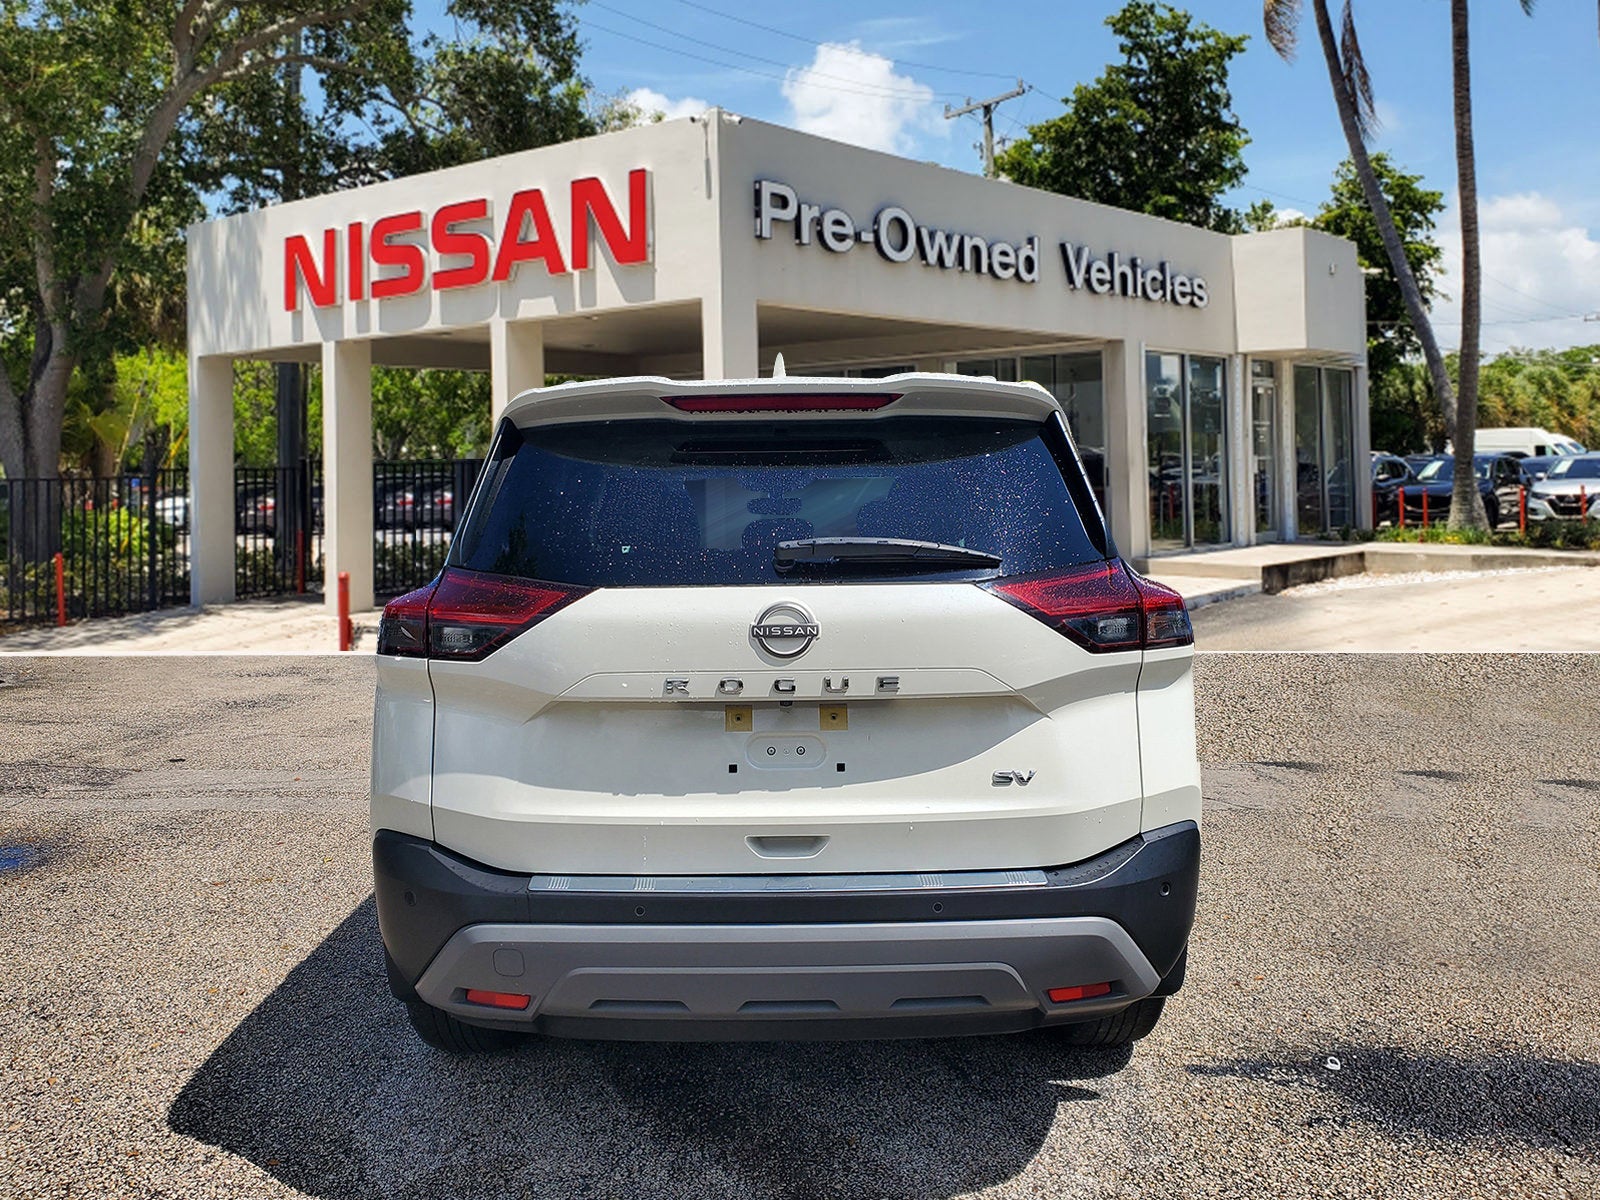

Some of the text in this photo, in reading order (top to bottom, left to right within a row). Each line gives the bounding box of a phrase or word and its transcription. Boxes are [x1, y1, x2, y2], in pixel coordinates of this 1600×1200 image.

[284, 168, 650, 312] NISSAN
[754, 179, 1209, 308] Pre-Owned Vehicles
[752, 625, 818, 637] NISSAN
[664, 675, 900, 695] ROGUE
[991, 769, 1036, 787] SV
